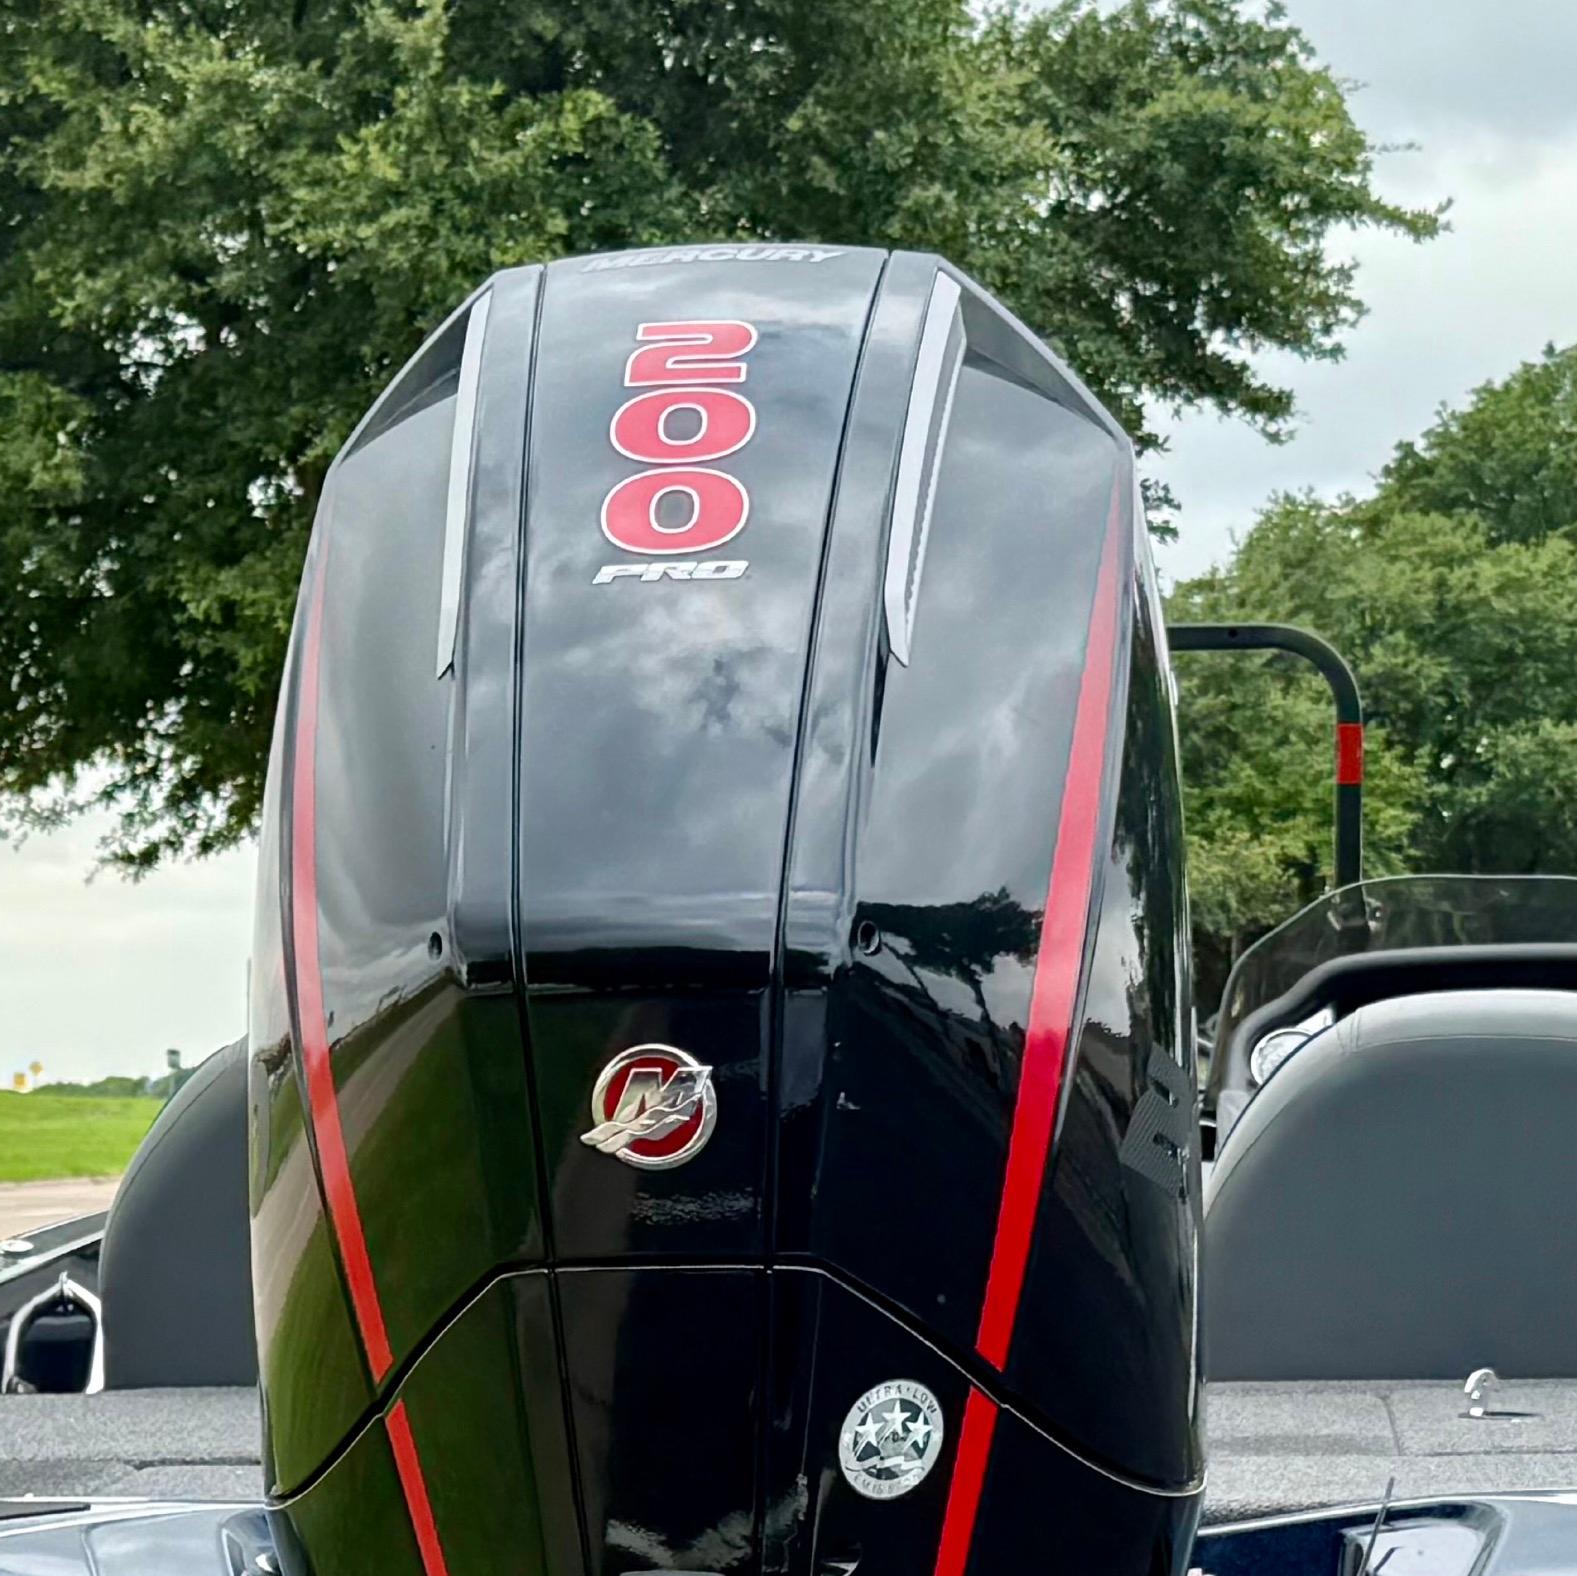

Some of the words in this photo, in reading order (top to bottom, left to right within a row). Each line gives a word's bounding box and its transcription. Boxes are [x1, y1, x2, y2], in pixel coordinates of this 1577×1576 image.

[580, 249, 848, 274] MERCURY
[600, 319, 759, 555] 200
[591, 560, 750, 585] PRO
